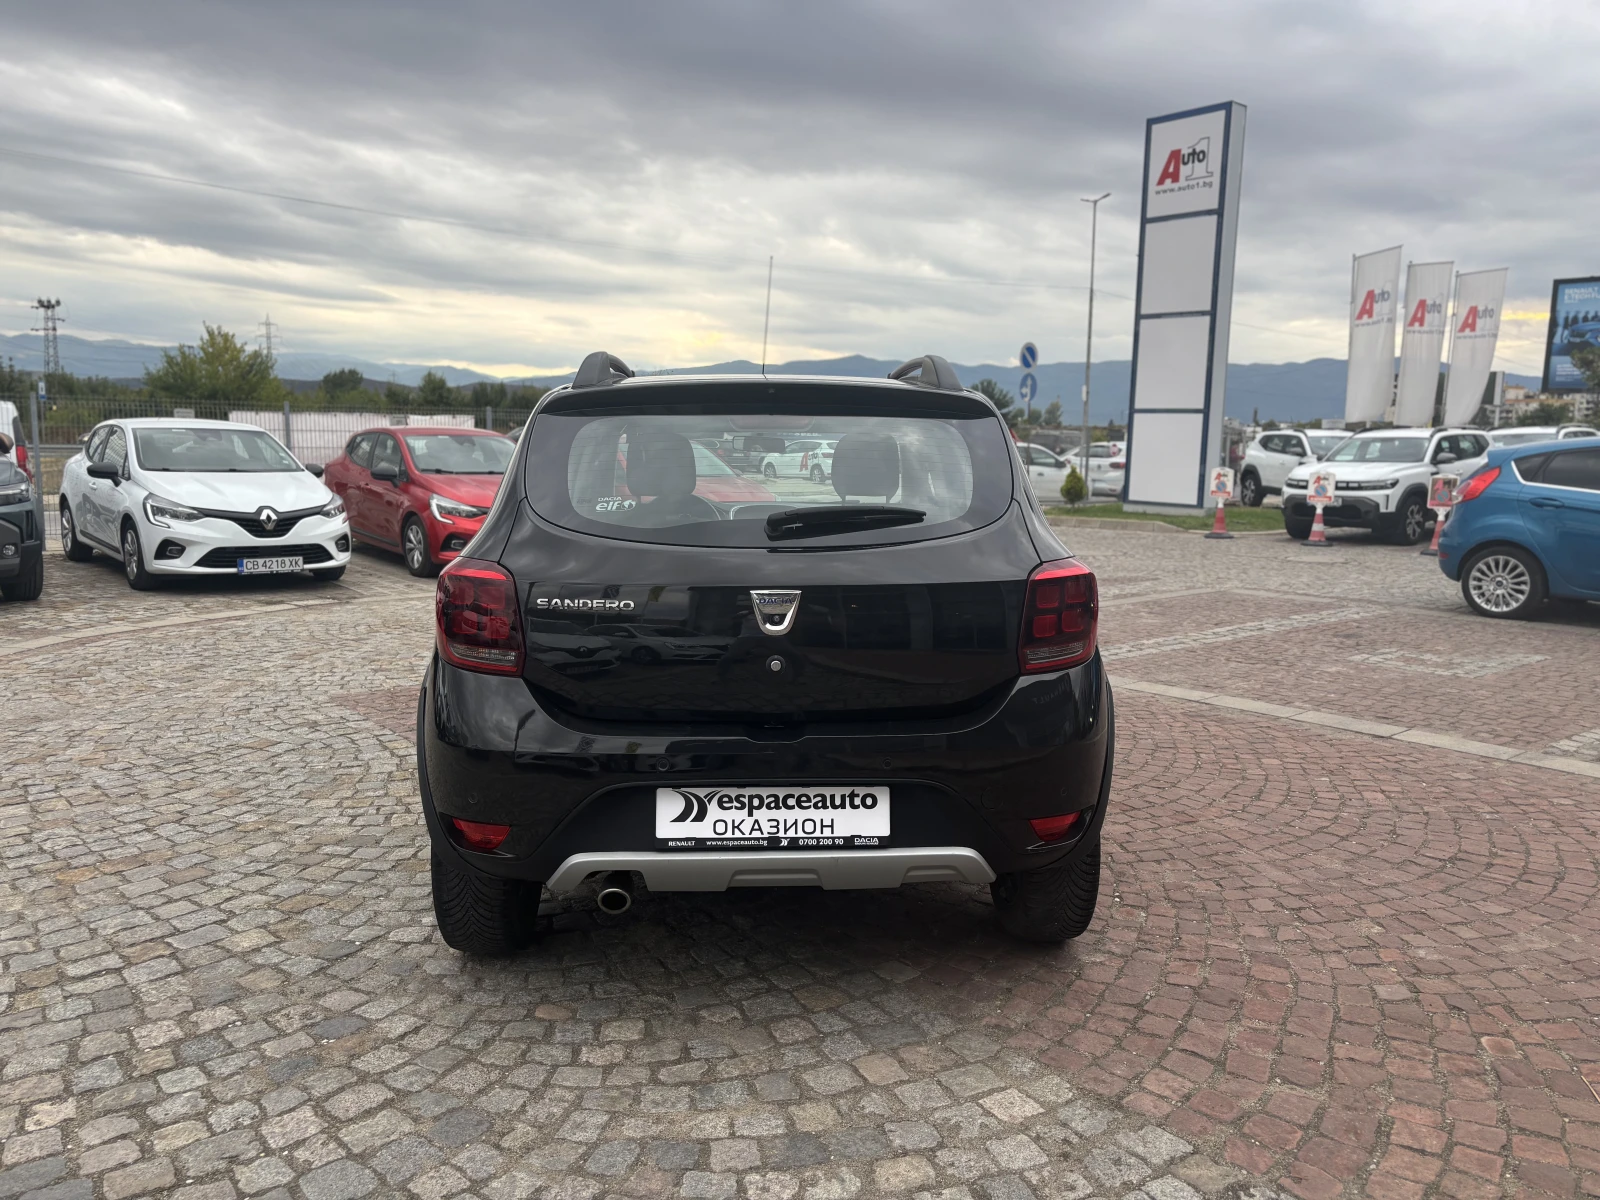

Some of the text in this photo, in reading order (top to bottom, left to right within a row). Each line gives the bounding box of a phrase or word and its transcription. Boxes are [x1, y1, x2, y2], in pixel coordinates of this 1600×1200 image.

[1155, 181, 1213, 195] www.auto1.bg
[595, 501, 621, 511] elf
[245, 560, 260, 571] CB
[261, 559, 287, 570] 4218
[288, 557, 301, 569] XK
[536, 598, 635, 611] SANDERO
[716, 788, 878, 817] espaceauto
[712, 818, 835, 836] ОКАЗИОН
[706, 838, 768, 846] www.espaceauto.bg
